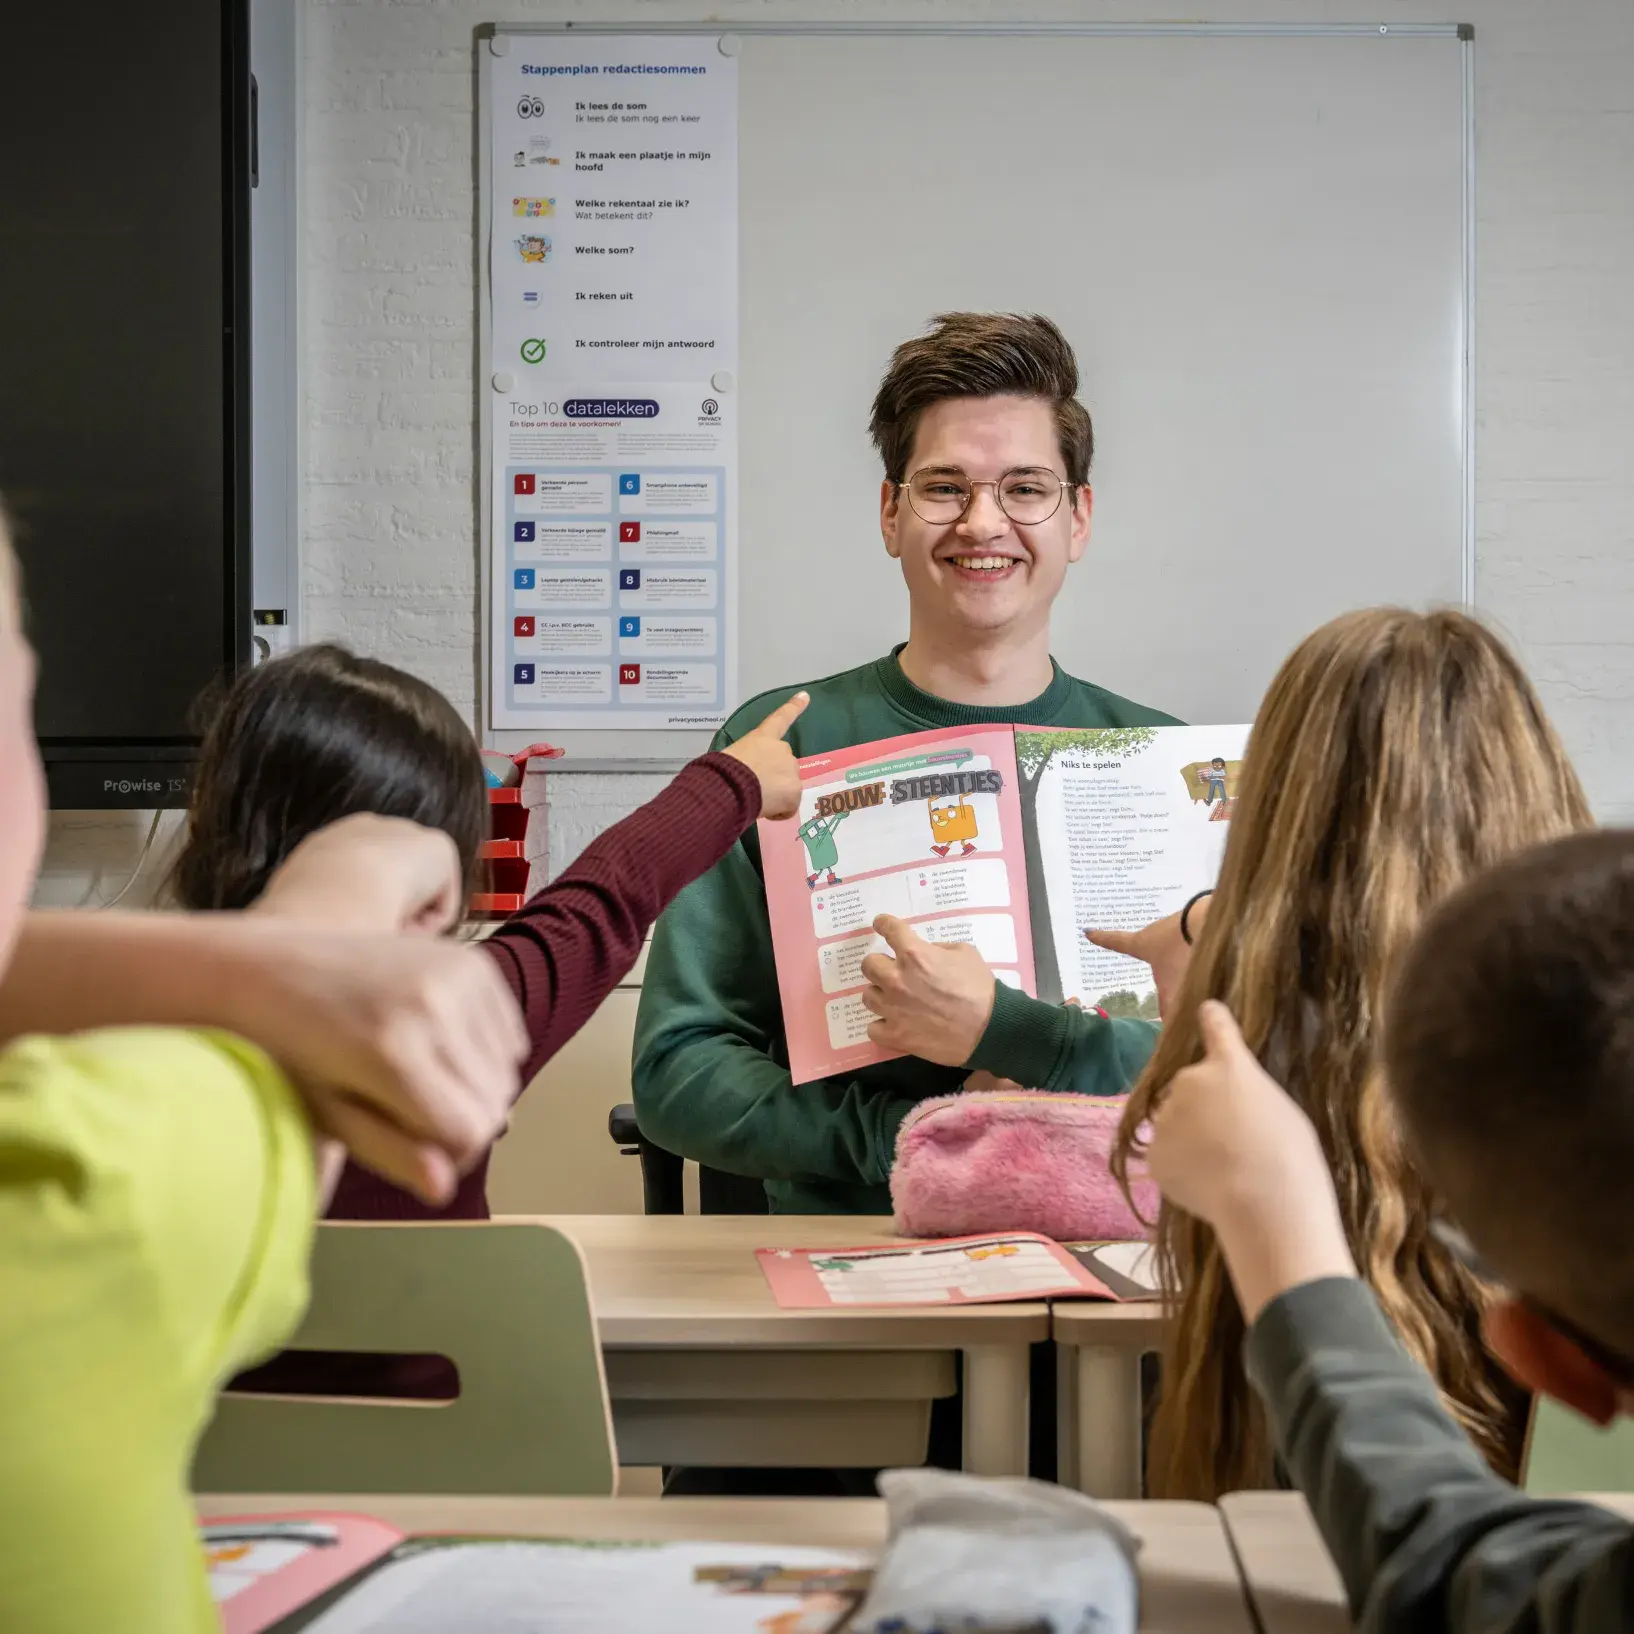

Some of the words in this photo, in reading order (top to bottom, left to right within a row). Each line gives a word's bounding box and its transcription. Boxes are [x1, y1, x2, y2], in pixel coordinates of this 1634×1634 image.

[521, 64, 599, 76] Stappenplan
[603, 64, 706, 74] redactiesommen
[640, 152, 673, 160] plaatje
[689, 152, 711, 160] mijn
[576, 292, 586, 300] Ik
[589, 292, 616, 300] reken
[620, 292, 633, 300] uit
[643, 340, 664, 349] mijn
[667, 340, 714, 348] antwoord
[509, 402, 538, 417] Top
[543, 402, 558, 414] 10
[567, 402, 655, 415] datalekken
[522, 481, 527, 489] 1
[626, 481, 634, 489] 6
[521, 528, 528, 536] 2
[626, 528, 634, 537] 7
[521, 575, 528, 584] 3
[626, 576, 633, 584] 8
[520, 623, 528, 631] 4
[626, 623, 633, 631] 9
[521, 671, 528, 679] 5
[623, 671, 635, 679] 10
[1093, 761, 1121, 770] spelen
[819, 783, 880, 816] BOUW
[893, 771, 1001, 800] STEENTJES
